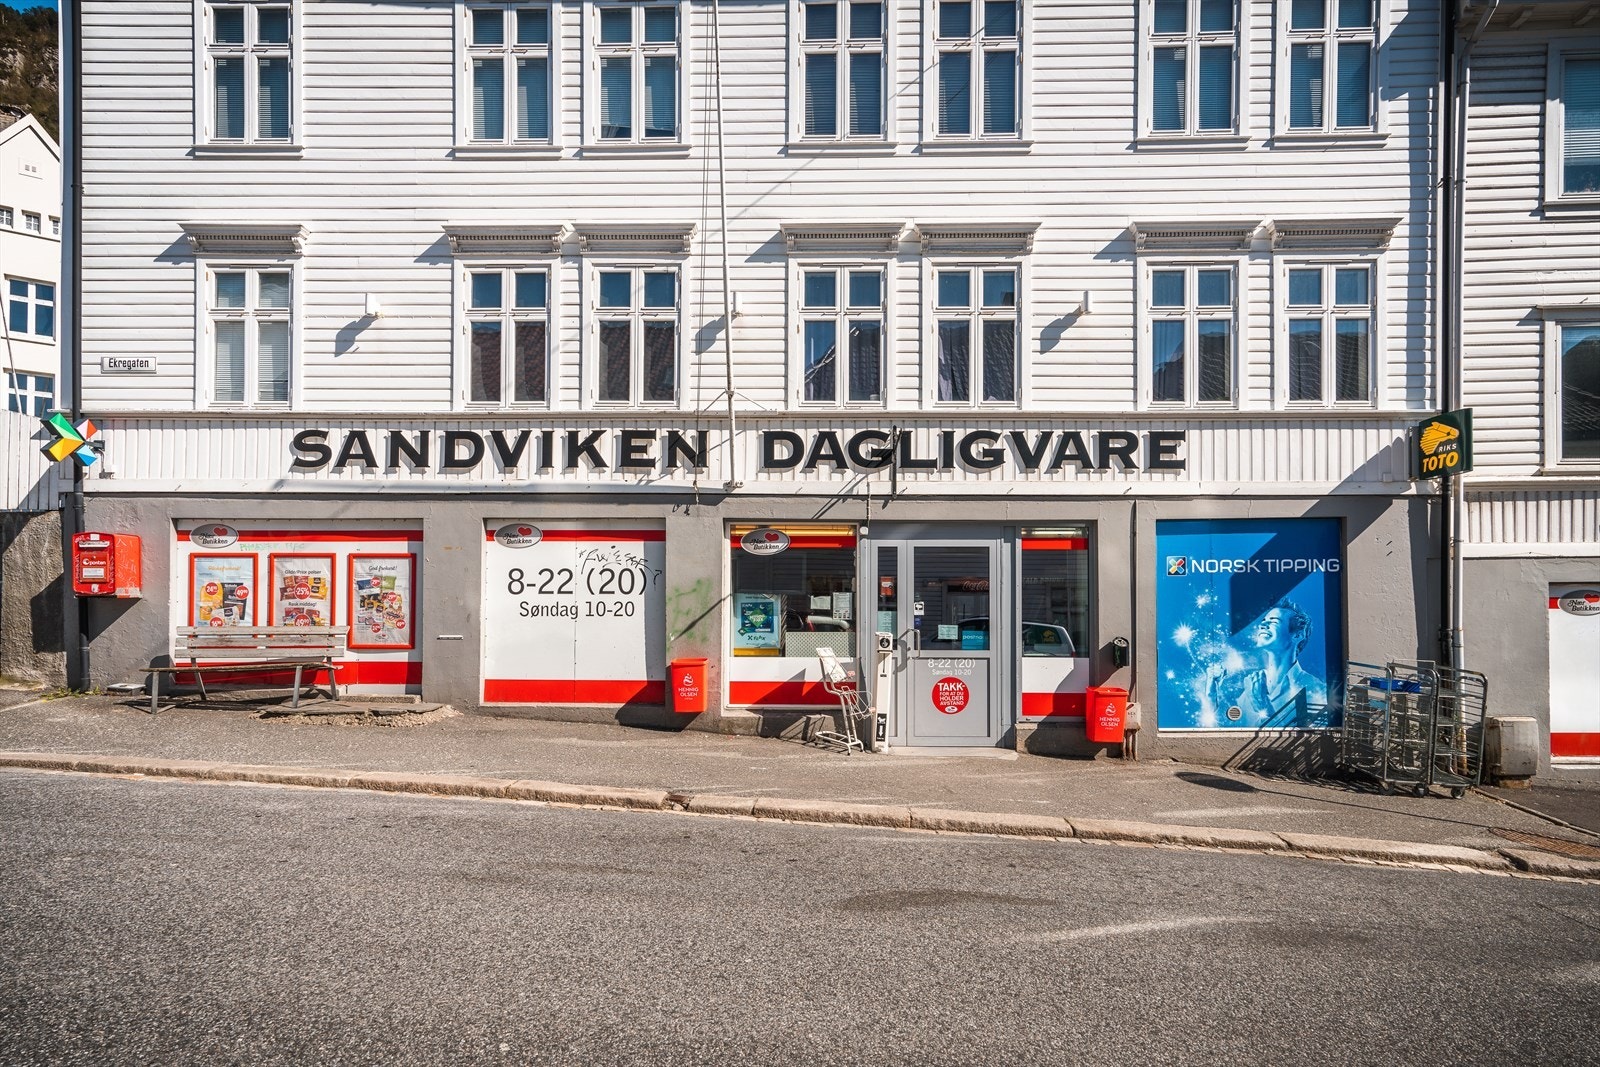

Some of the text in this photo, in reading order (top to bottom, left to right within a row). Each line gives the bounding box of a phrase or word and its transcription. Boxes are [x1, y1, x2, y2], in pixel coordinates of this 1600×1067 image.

[108, 357, 149, 370] Ekregaten
[291, 429, 1187, 469] SANDVIKEN DAGLIGVARE
[1438, 443, 1457, 452] RIKS
[1422, 451, 1459, 473] TOTO
[753, 543, 780, 551] Butikken
[1191, 558, 1341, 573] NORSK TIPPING
[507, 567, 574, 595] 8-22
[586, 567, 647, 596] (20)
[519, 601, 635, 619] Søndag 10-20
[1566, 599, 1586, 607] Nær
[927, 658, 976, 669] 8-22 (20)
